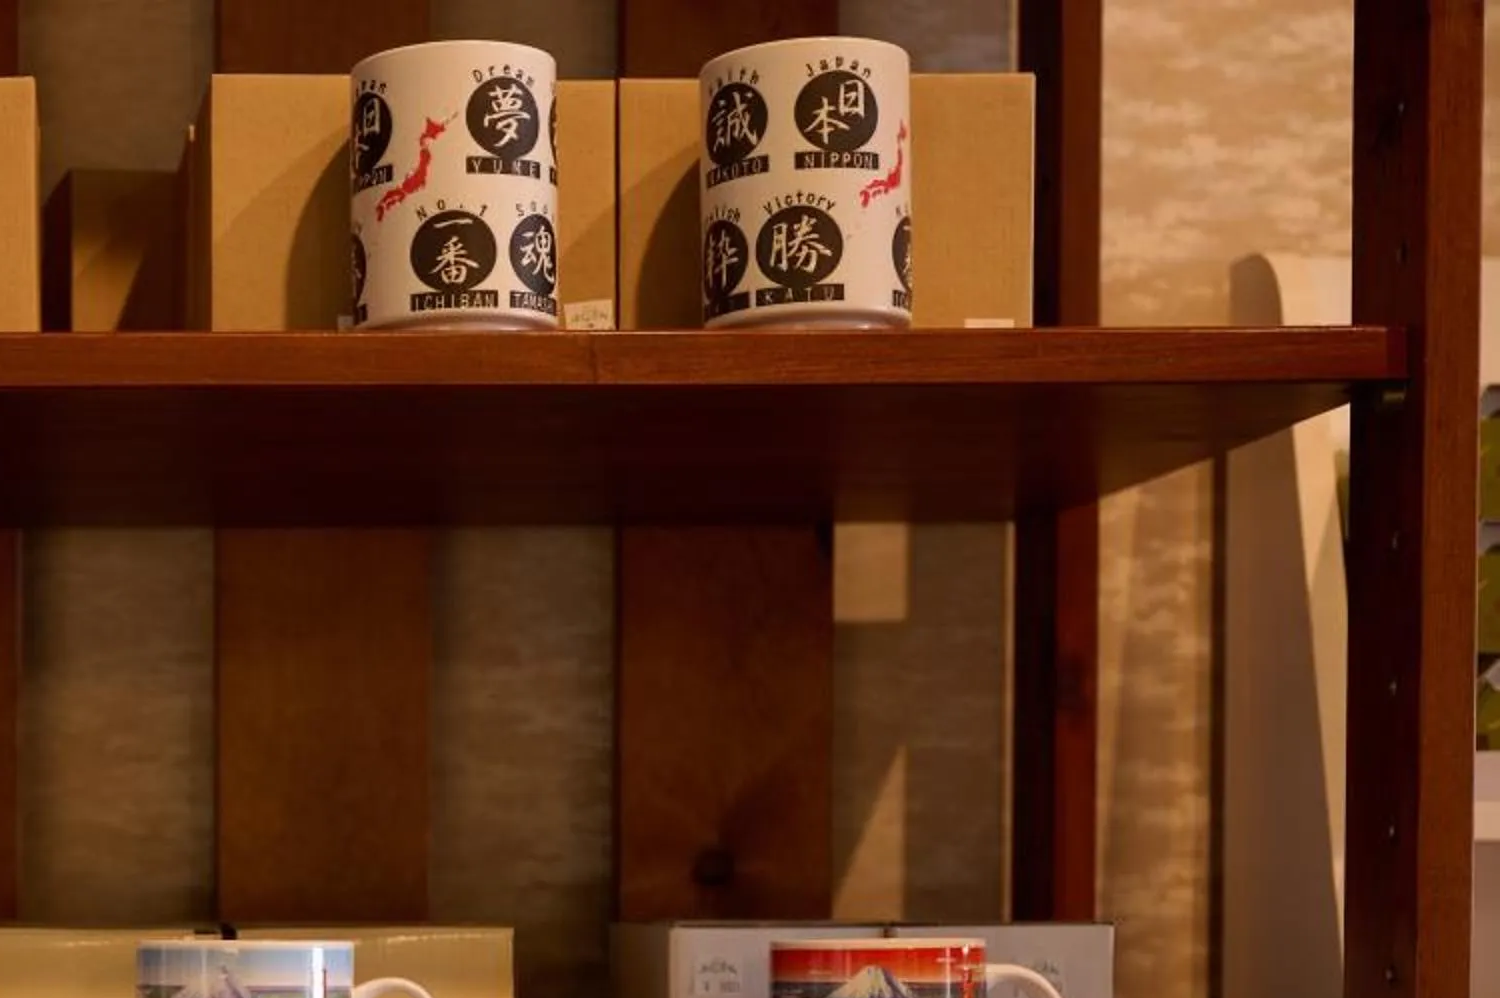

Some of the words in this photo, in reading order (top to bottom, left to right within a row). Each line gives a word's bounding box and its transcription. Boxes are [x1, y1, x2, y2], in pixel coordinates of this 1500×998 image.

[471, 64, 536, 88] Dream
[805, 56, 872, 79] Japan
[483, 83, 532, 148] 夢
[711, 91, 757, 152] 誠
[804, 79, 866, 145] 日本
[471, 159, 542, 178] YUME
[803, 153, 874, 170] NIPPON
[762, 190, 837, 217] Victory
[429, 218, 481, 285] 一番
[521, 224, 556, 285] 魂
[769, 214, 833, 274] 勝
[414, 294, 495, 311] ICHIBAN
